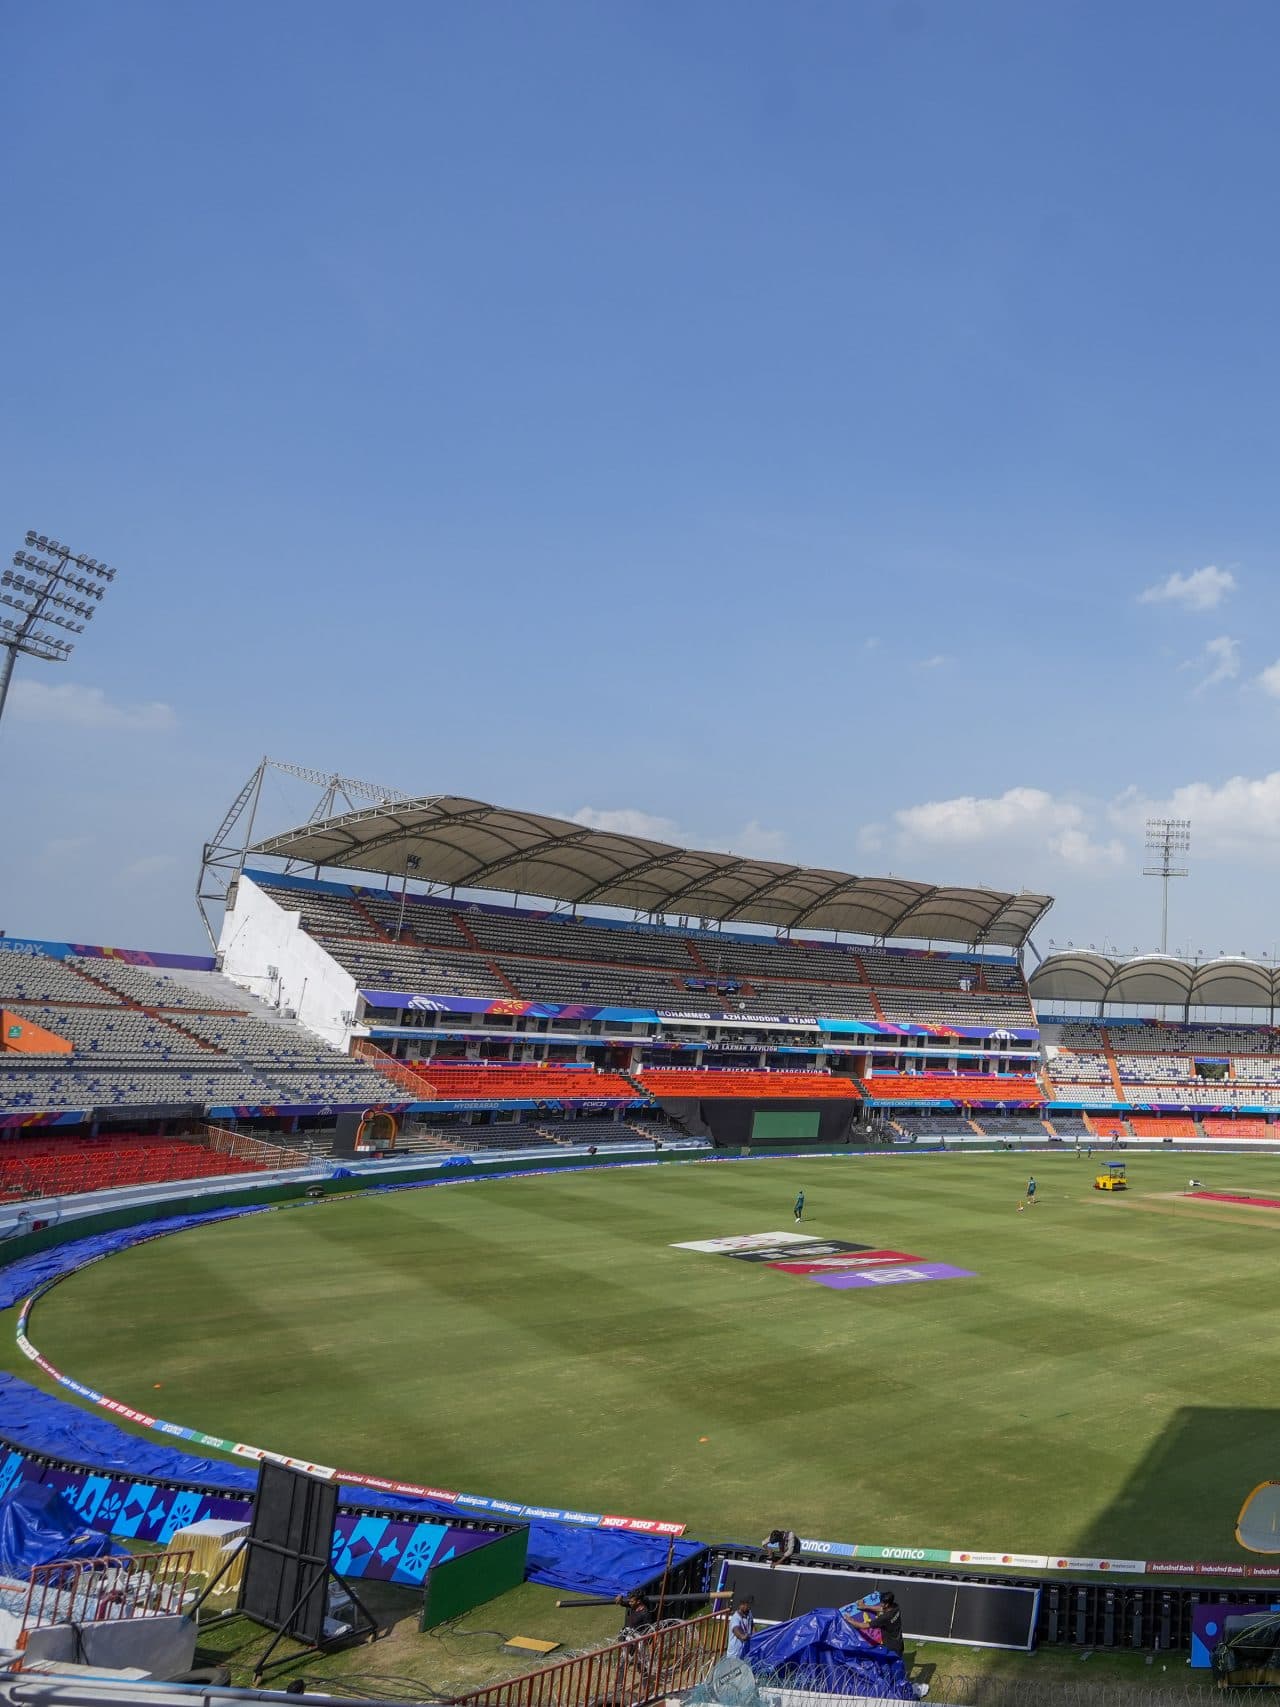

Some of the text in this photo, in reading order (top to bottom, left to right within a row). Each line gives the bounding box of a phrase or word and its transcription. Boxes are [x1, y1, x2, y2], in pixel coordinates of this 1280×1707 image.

[15, 942, 44, 954] DAY
[657, 1010, 711, 1020] MOHAMMED
[602, 1517, 683, 1533] MRF MRF MRF
[800, 1540, 831, 1552] amco
[881, 1547, 925, 1559] aramco
[1201, 1565, 1227, 1573] IndusInd
